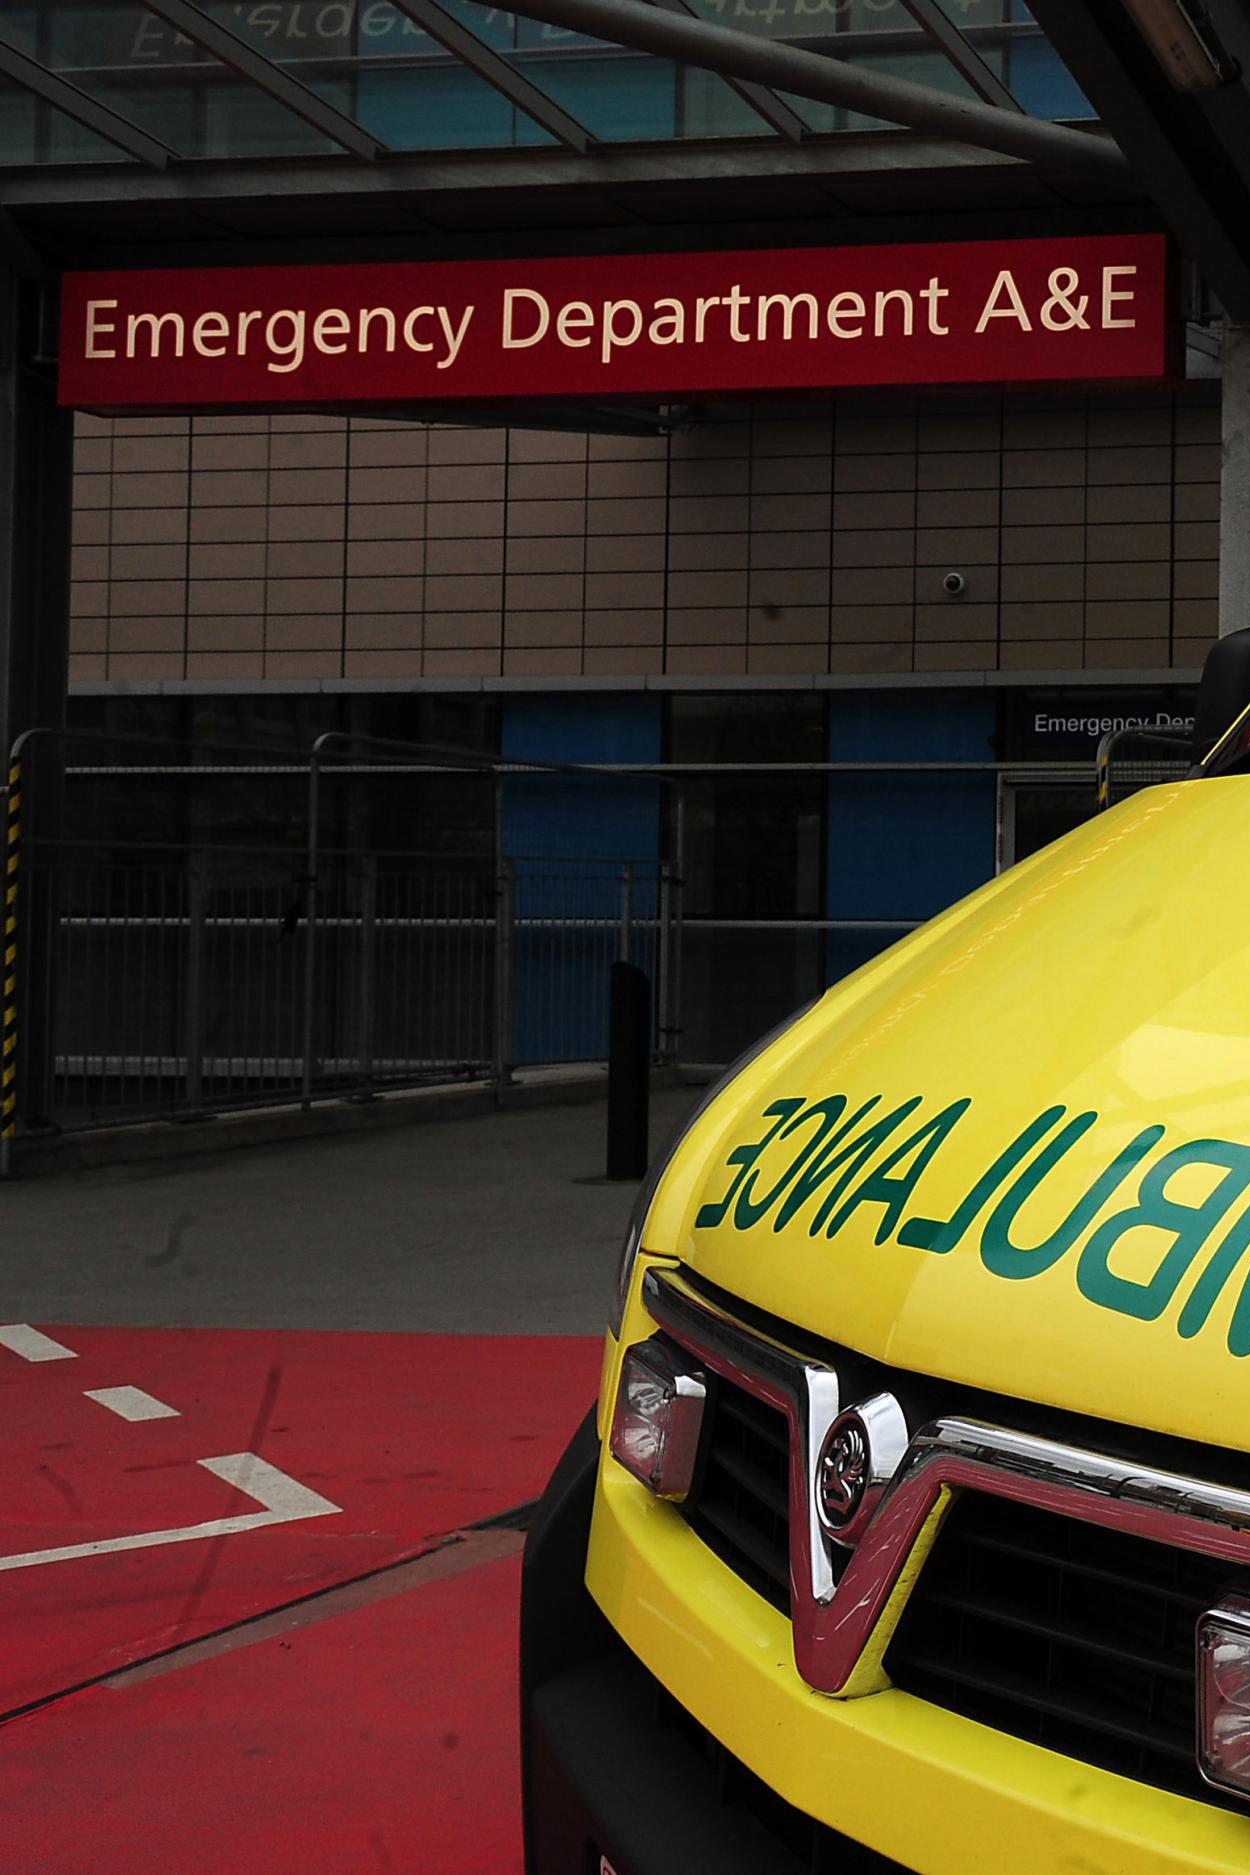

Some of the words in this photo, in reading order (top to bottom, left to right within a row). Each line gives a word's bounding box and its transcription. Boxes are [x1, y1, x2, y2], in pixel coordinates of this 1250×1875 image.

[84, 299, 475, 373] Emergency
[502, 276, 949, 364] Department
[974, 265, 1137, 333] A&E
